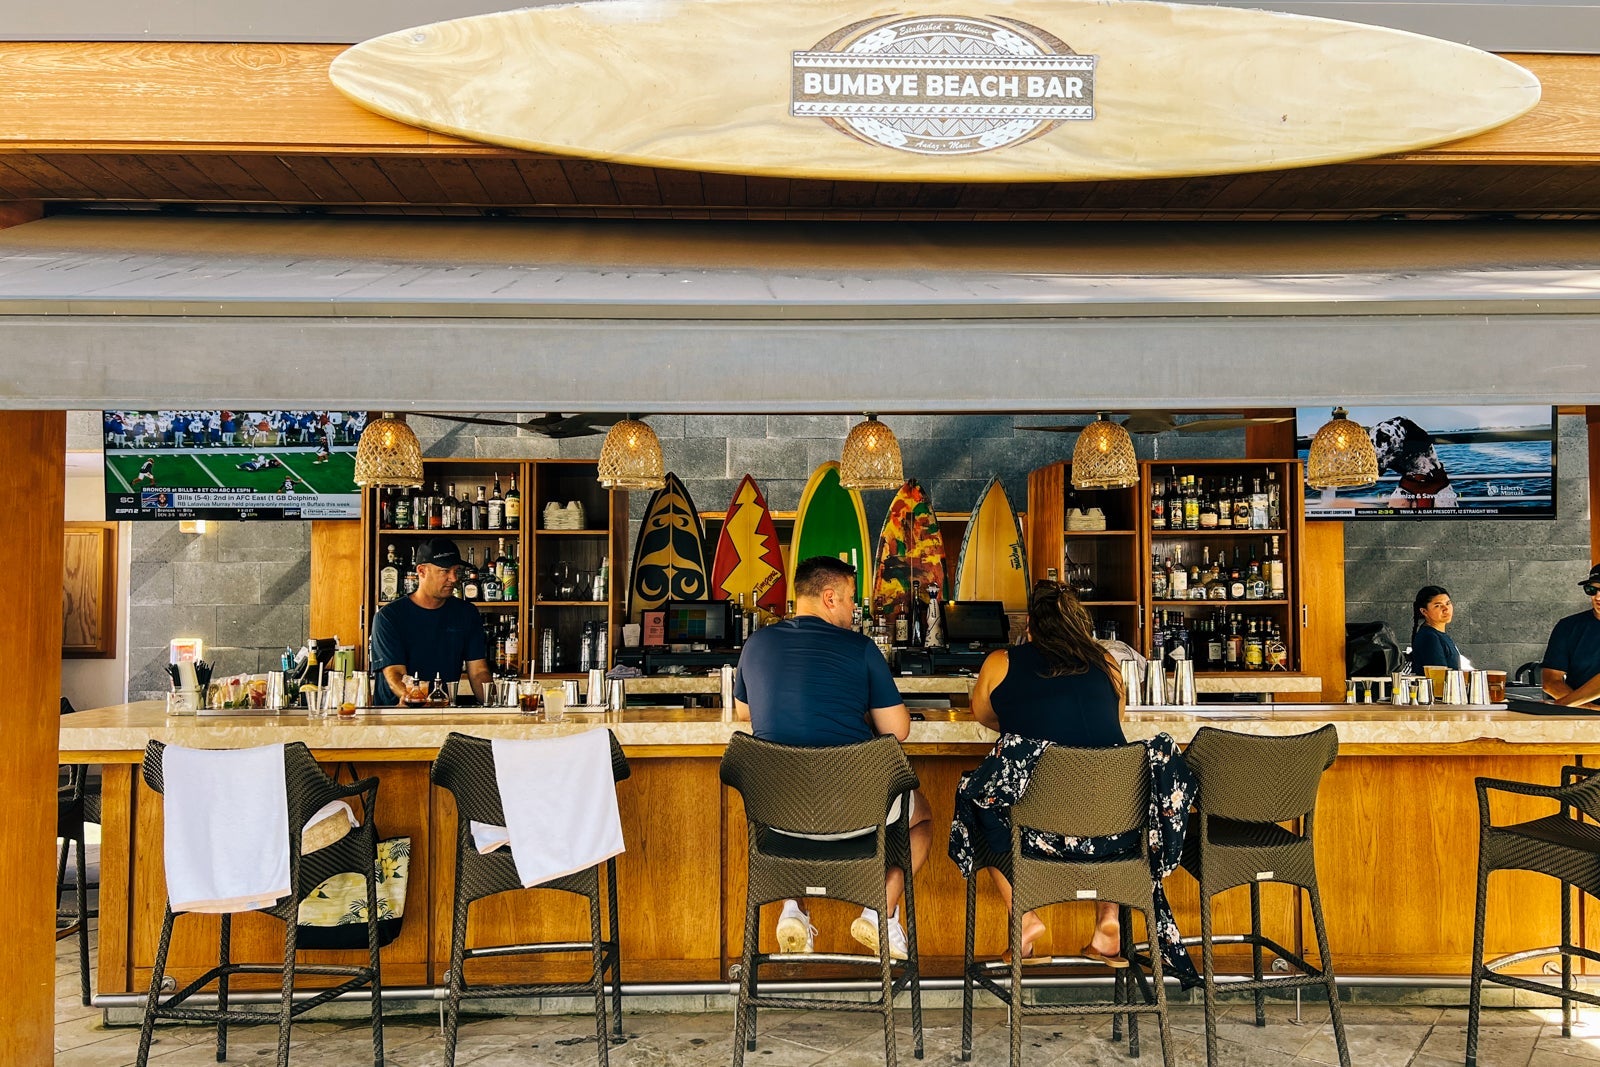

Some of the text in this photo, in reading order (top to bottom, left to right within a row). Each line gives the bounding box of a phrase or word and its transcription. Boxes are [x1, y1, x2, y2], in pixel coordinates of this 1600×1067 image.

[899, 23, 990, 36] Established Whenever
[803, 72, 1084, 99] BUMBYE BEACH BAR
[915, 140, 971, 151] Andaz Maui
